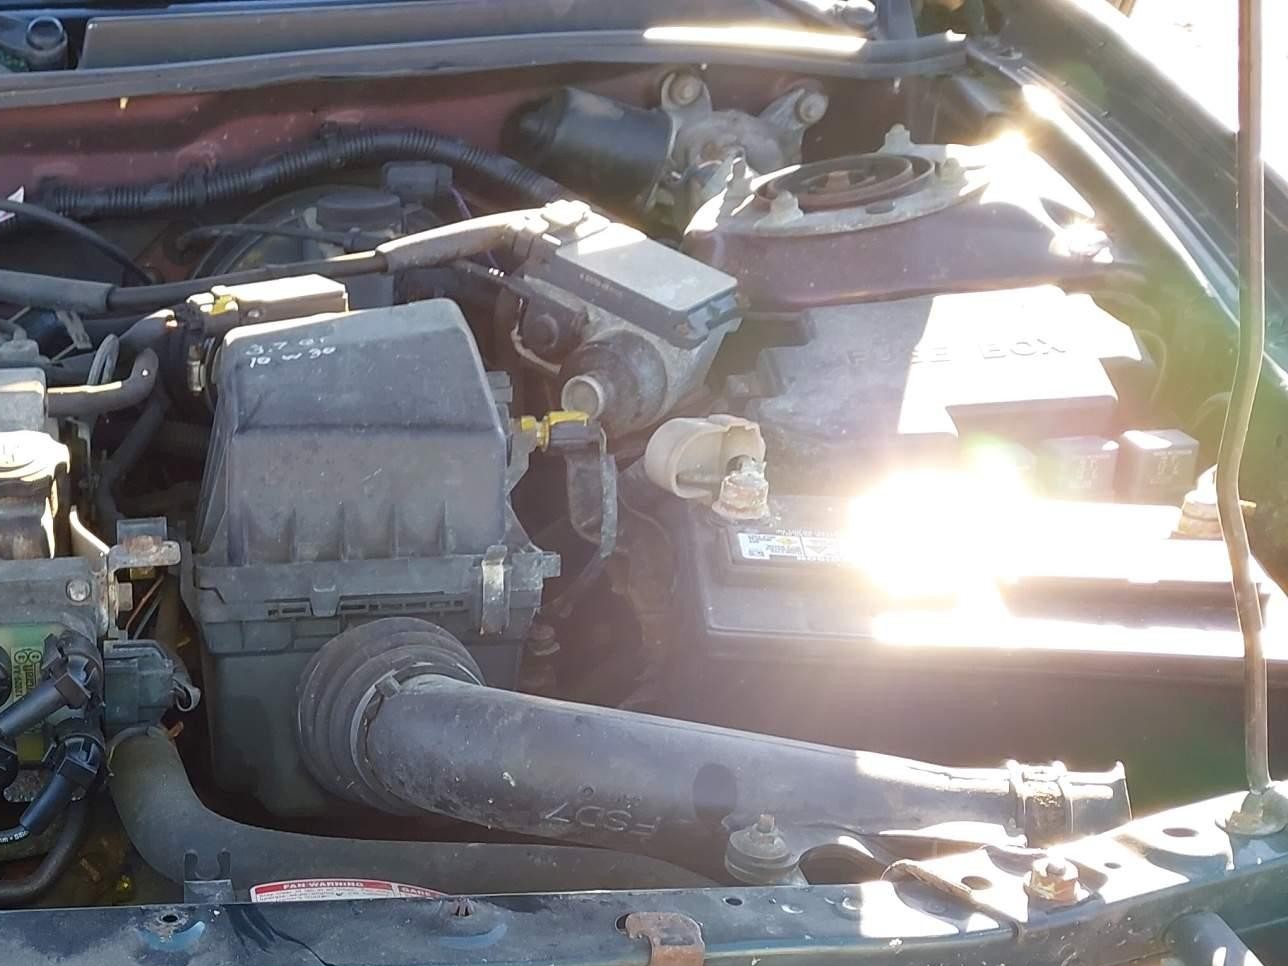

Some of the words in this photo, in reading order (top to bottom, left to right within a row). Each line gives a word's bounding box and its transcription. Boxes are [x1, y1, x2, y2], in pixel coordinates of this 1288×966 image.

[249, 356, 272, 369] 10
[308, 346, 337, 360] 30
[978, 337, 1067, 360] BOX
[282, 881, 306, 890] FAN
[308, 880, 364, 889] WARNING
